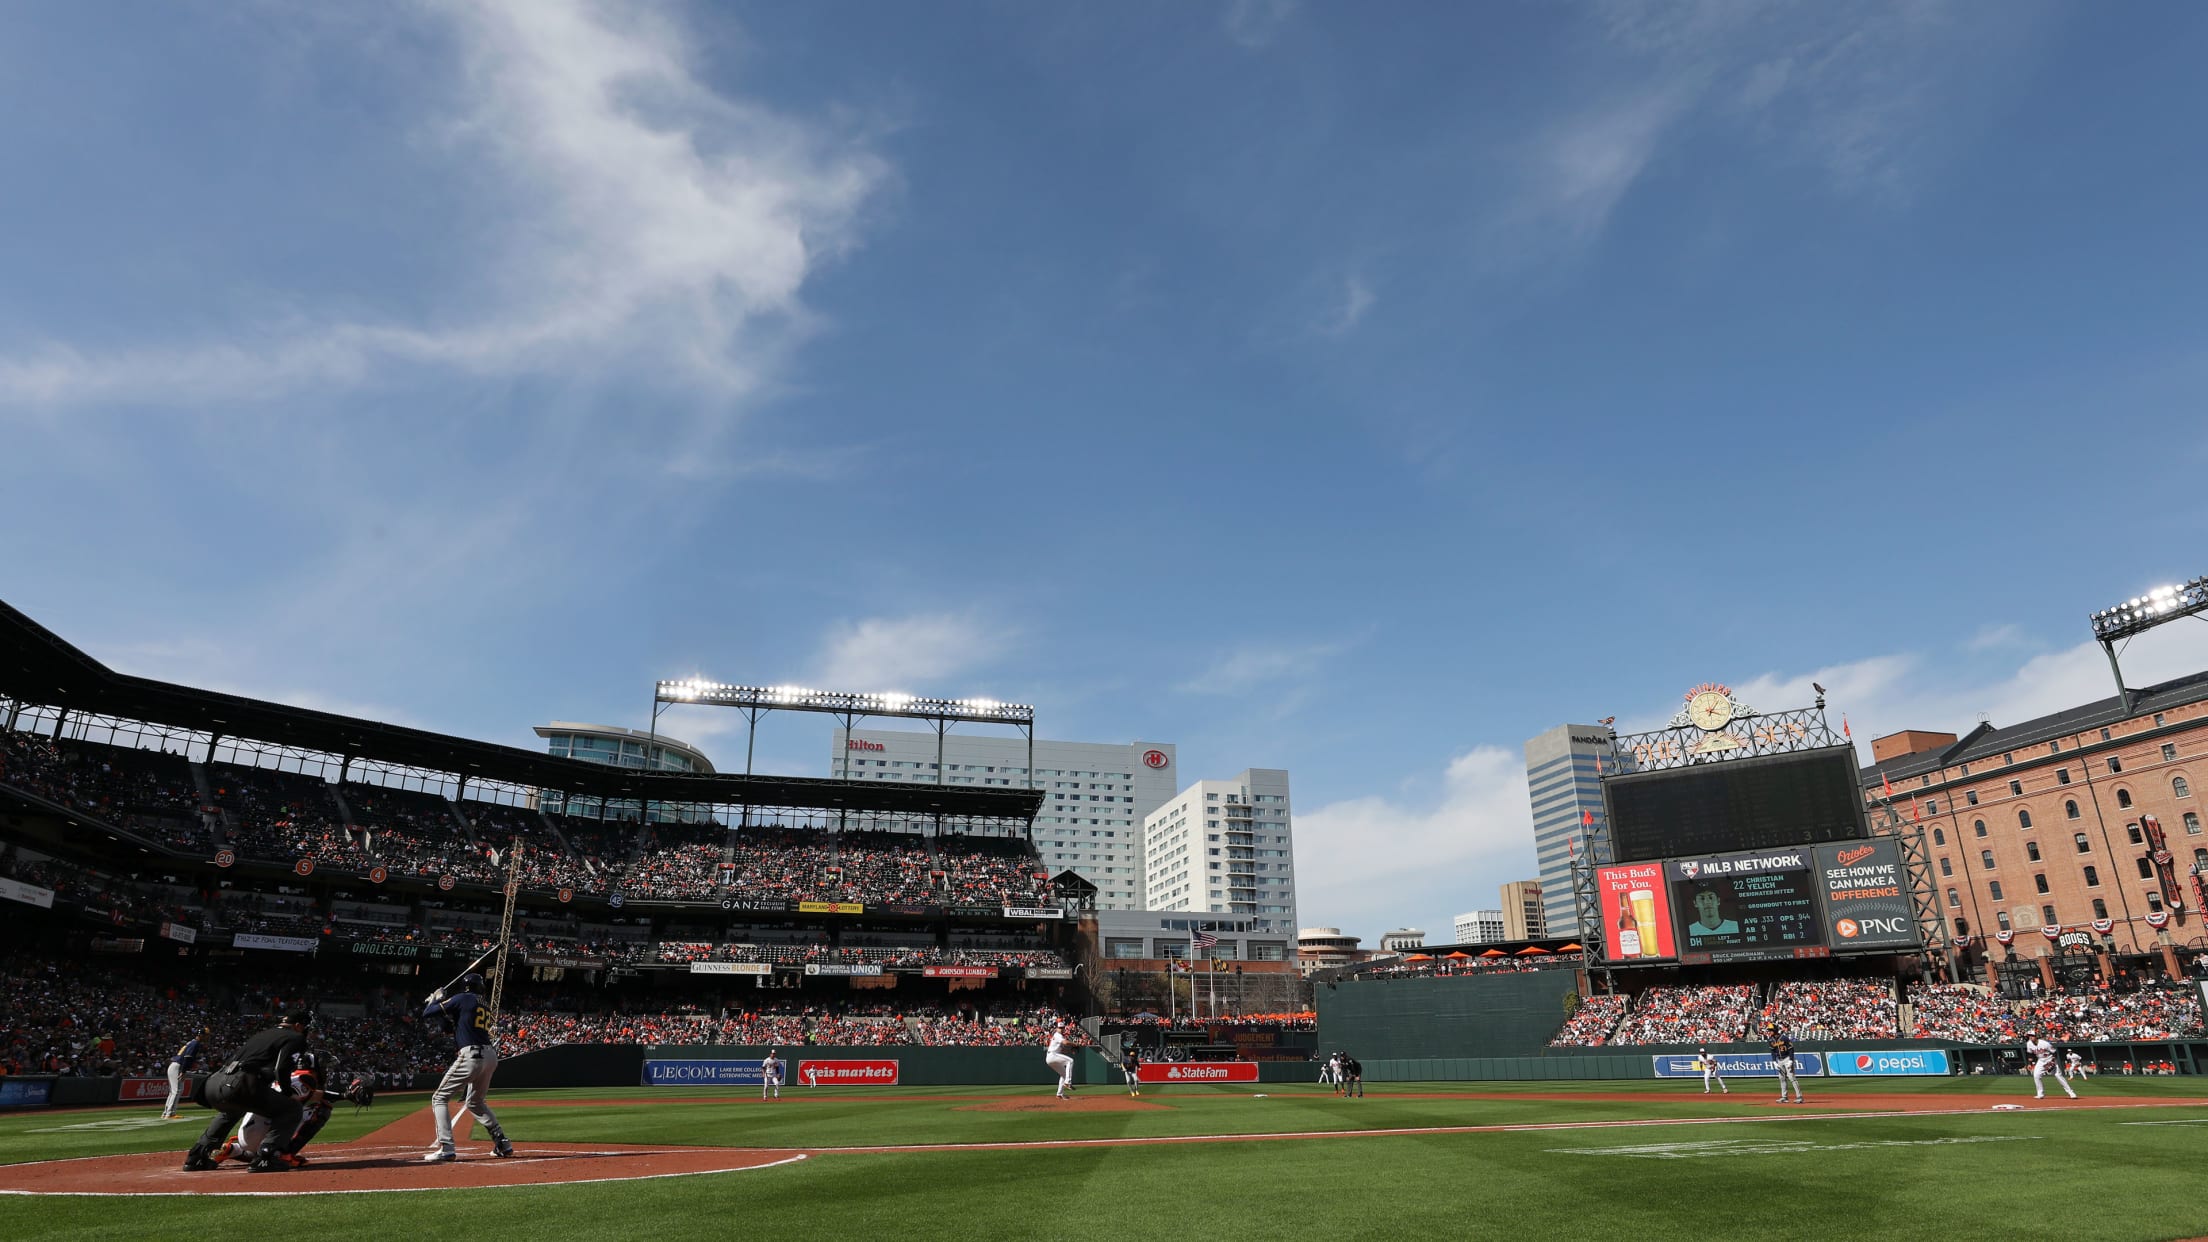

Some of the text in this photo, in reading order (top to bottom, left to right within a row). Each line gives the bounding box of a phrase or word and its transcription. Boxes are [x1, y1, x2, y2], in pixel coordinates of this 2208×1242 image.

[1684, 682, 1731, 701] ORIOLES
[1632, 722, 1806, 763] THE SUN
[218, 853, 233, 864] 20
[1837, 845, 1875, 865] Orioles
[301, 862, 308, 872] 5
[1703, 855, 1802, 874] MLB NETWORK
[374, 870, 381, 880] 4
[1604, 868, 1656, 881] This Bud's
[1827, 864, 1896, 879] SEE HOW WE
[441, 877, 453, 888] 22
[1733, 880, 1744, 890] 22
[1746, 875, 1784, 884] CHRISTIAN
[1829, 875, 1897, 890] CAN MAKE A
[1611, 880, 1652, 891] For You.
[1747, 881, 1776, 890] YELICH
[562, 891, 568, 899] 8
[1831, 887, 1900, 901] DIFFERENCE
[611, 896, 621, 905] 42
[722, 900, 760, 910] GANZ
[1010, 908, 1033, 917] WBAL
[1780, 914, 1795, 922] OPS
[1859, 917, 1908, 935] PNC
[1690, 937, 1703, 947] DH
[352, 942, 418, 957] ORIOLES.COM
[692, 963, 761, 972] GUINNESS BLONDE
[851, 964, 881, 974] UNION
[1717, 1061, 1762, 1071] MedStar
[1879, 1055, 1926, 1072] pepsi
[837, 1066, 893, 1077] markets
